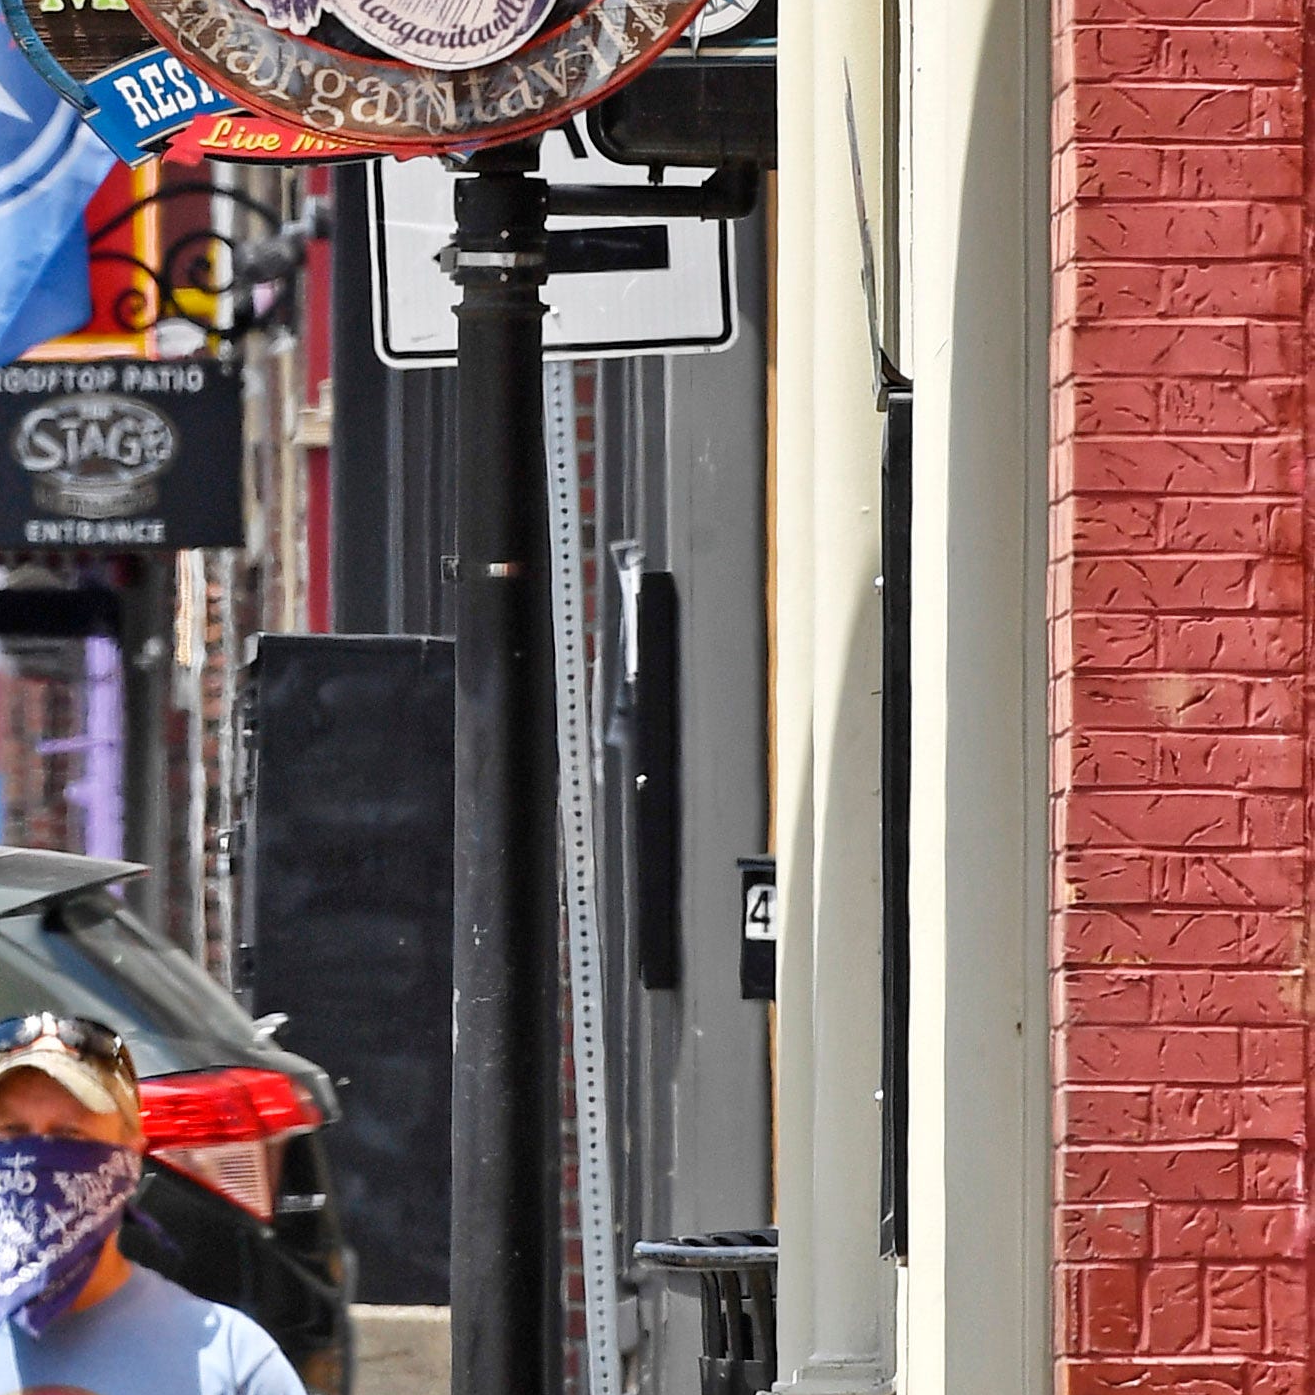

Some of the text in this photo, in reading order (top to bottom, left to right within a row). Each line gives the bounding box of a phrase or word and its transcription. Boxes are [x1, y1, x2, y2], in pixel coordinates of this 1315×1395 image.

[199, 119, 282, 153] Live
[122, 364, 205, 393] PATIO
[24, 518, 166, 544] ENTRANCE
[750, 890, 772, 933] 4
